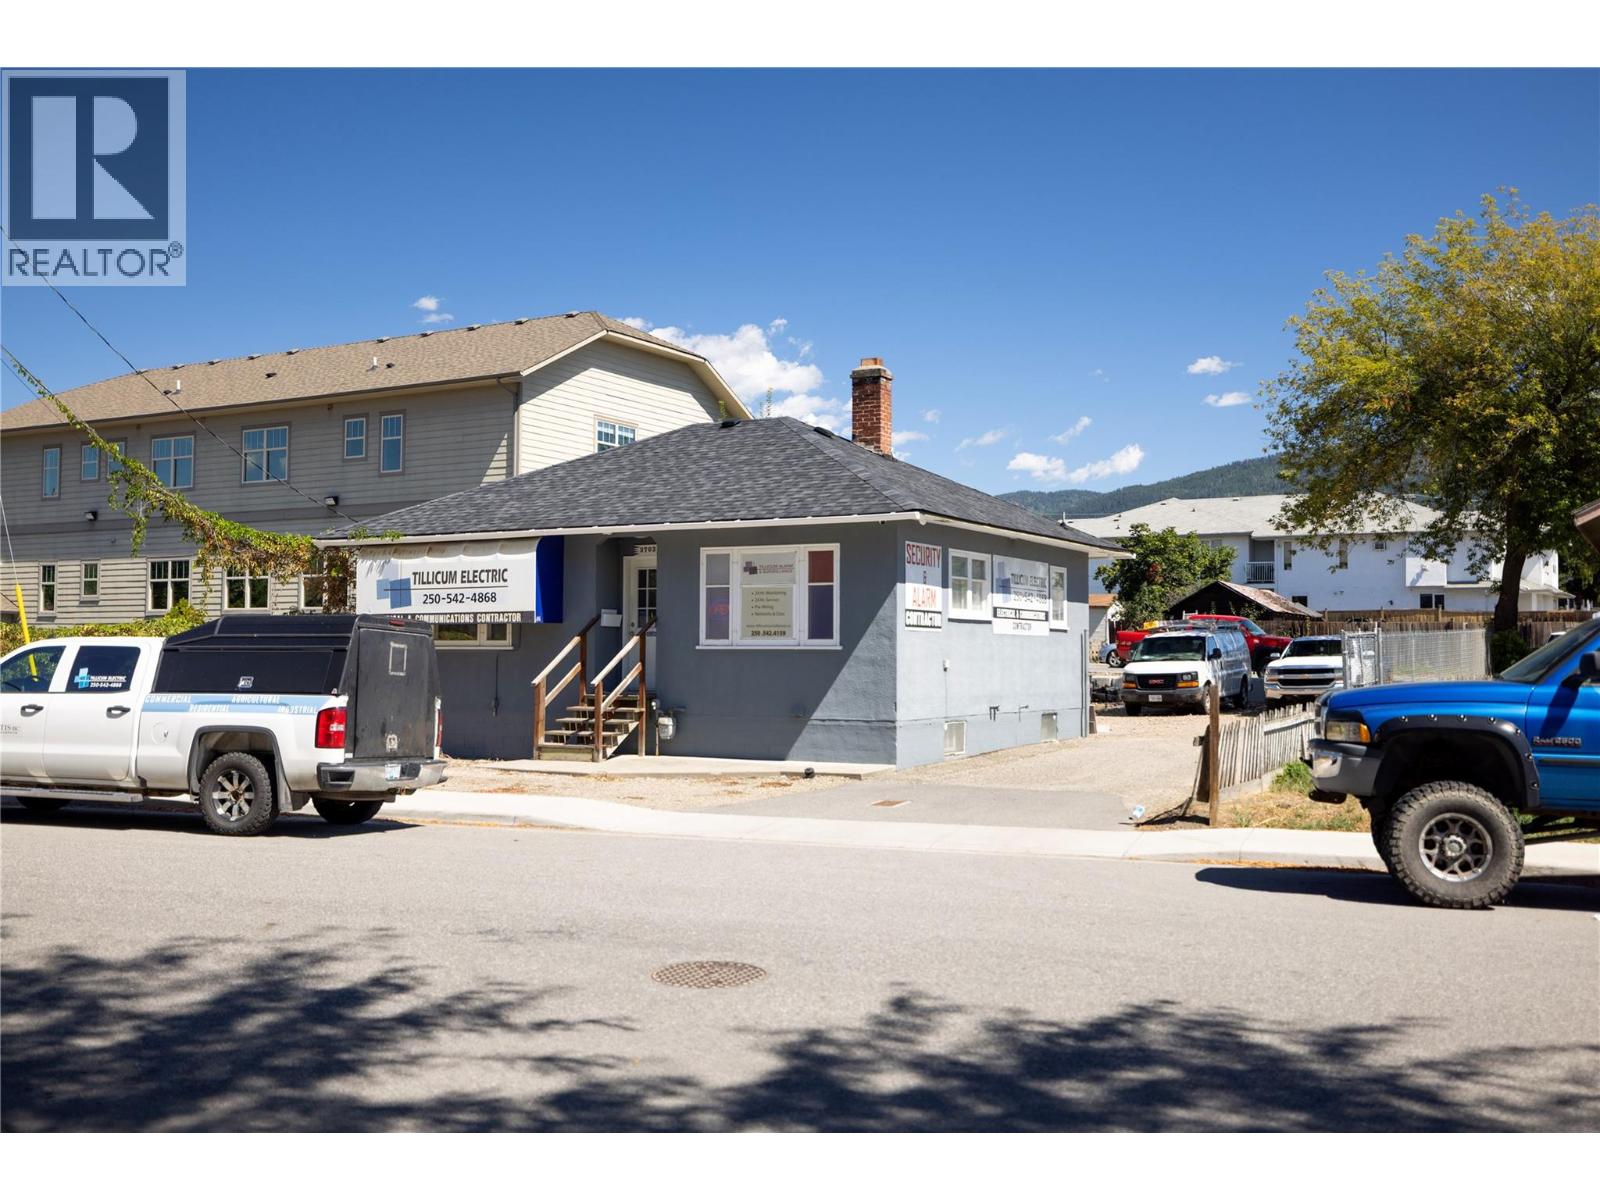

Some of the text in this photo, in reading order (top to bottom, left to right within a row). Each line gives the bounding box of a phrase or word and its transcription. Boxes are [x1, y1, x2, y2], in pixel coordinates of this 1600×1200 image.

[906, 543, 941, 568] SECURITY
[412, 568, 508, 585] TILLICUM ELECTRIC
[422, 592, 497, 604] 250-542-4868
[912, 586, 937, 608] ALARM
[415, 613, 474, 624] COMMUNICATIONS
[476, 612, 521, 623] CONTRACTOR
[144, 695, 191, 704] COMMERCIAL
[231, 695, 280, 704] AGRICULTURAL
[189, 704, 230, 713] RESIDENTIAL
[278, 705, 317, 714] INDUSTRIAL
